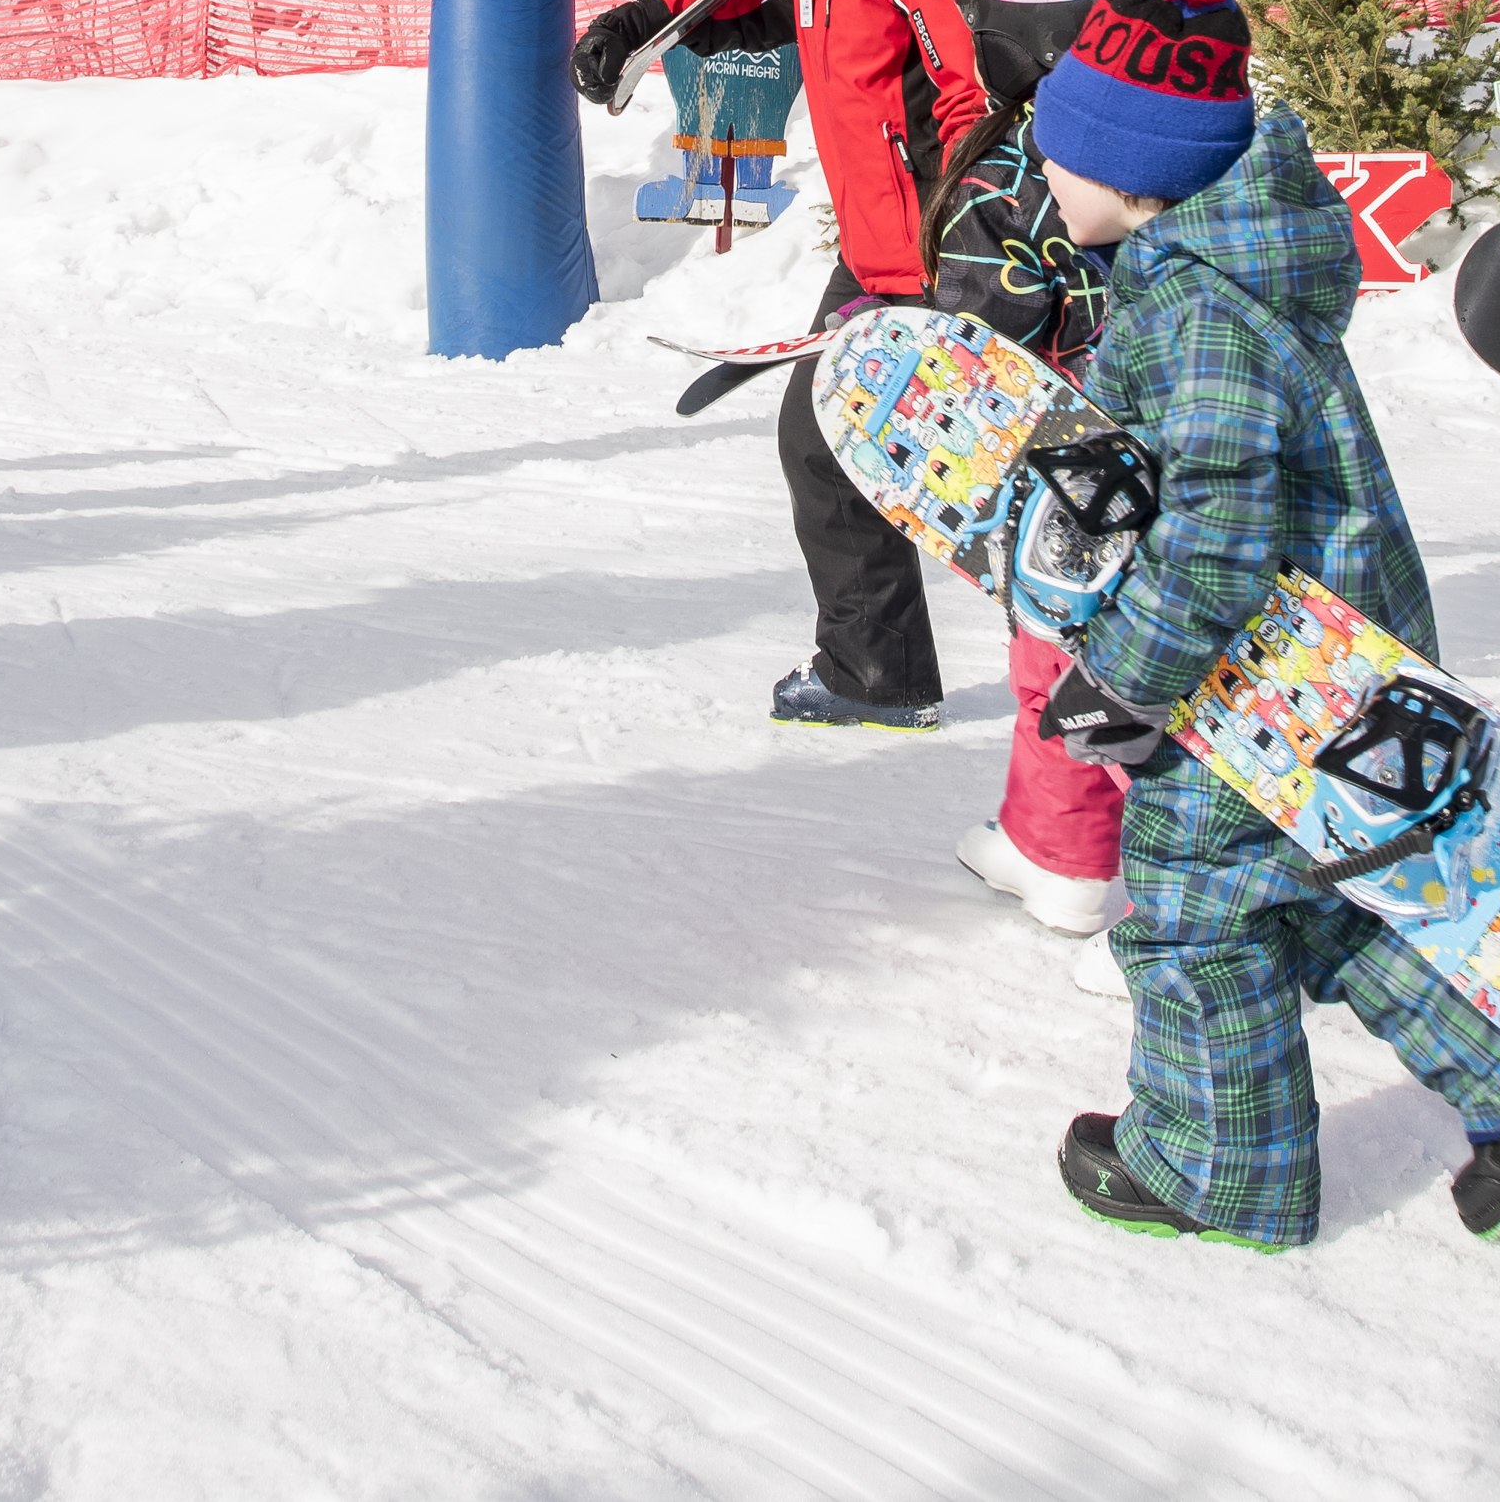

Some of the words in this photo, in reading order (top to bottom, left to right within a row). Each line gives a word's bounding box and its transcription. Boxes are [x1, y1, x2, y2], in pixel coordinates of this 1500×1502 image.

[913, 10, 941, 69] DESCENTE
[703, 60, 740, 76] MORIN
[741, 63, 781, 80] HEIGHTS
